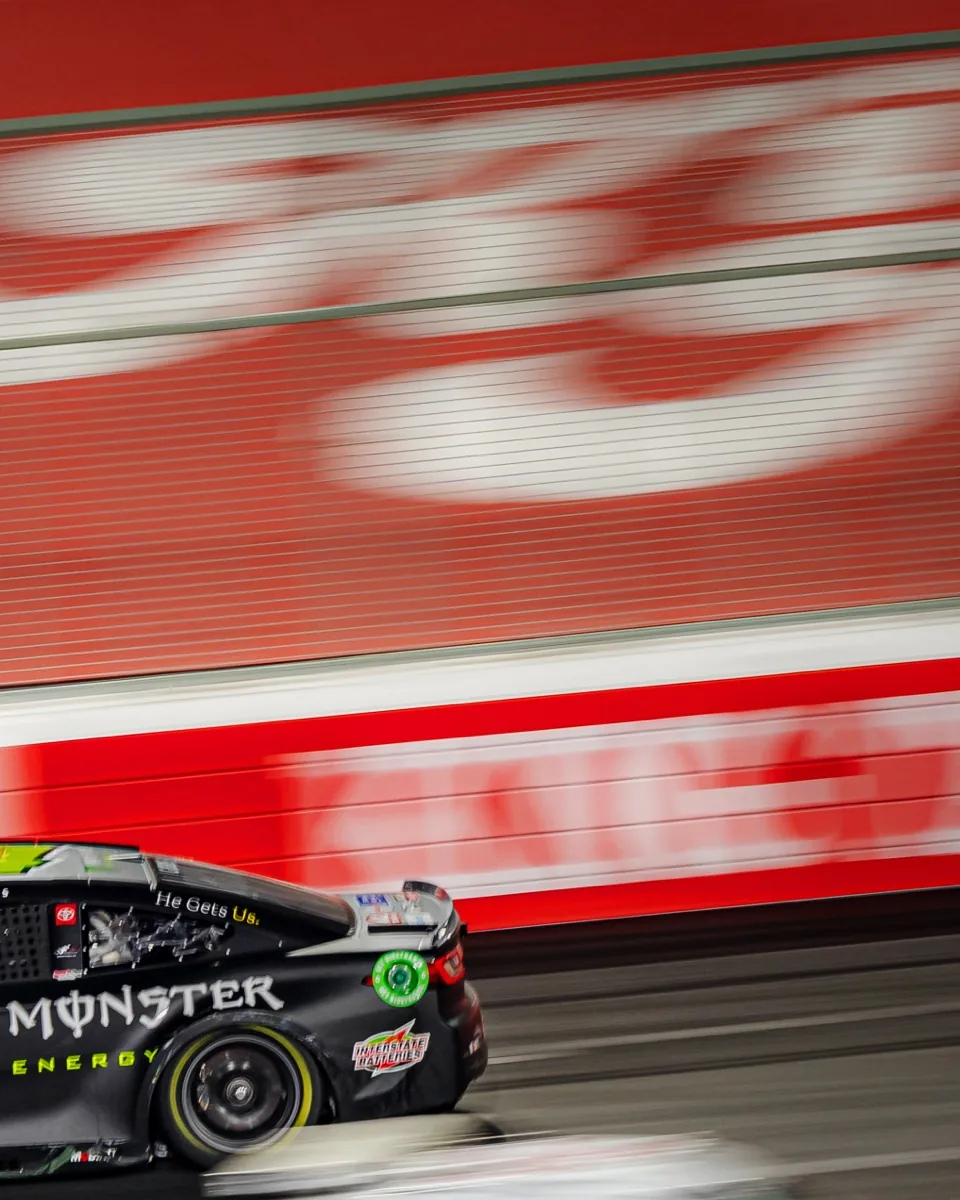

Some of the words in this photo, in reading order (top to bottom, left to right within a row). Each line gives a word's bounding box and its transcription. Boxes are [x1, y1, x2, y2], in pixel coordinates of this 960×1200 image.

[155, 890, 182, 909] He
[186, 897, 228, 919] Gets
[232, 905, 260, 926] Us.
[6, 975, 285, 1040] MONSTER
[357, 1039, 424, 1055] INTERSTATE
[359, 1051, 421, 1065] BATTERIES
[12, 1049, 159, 1075] ENERGY
